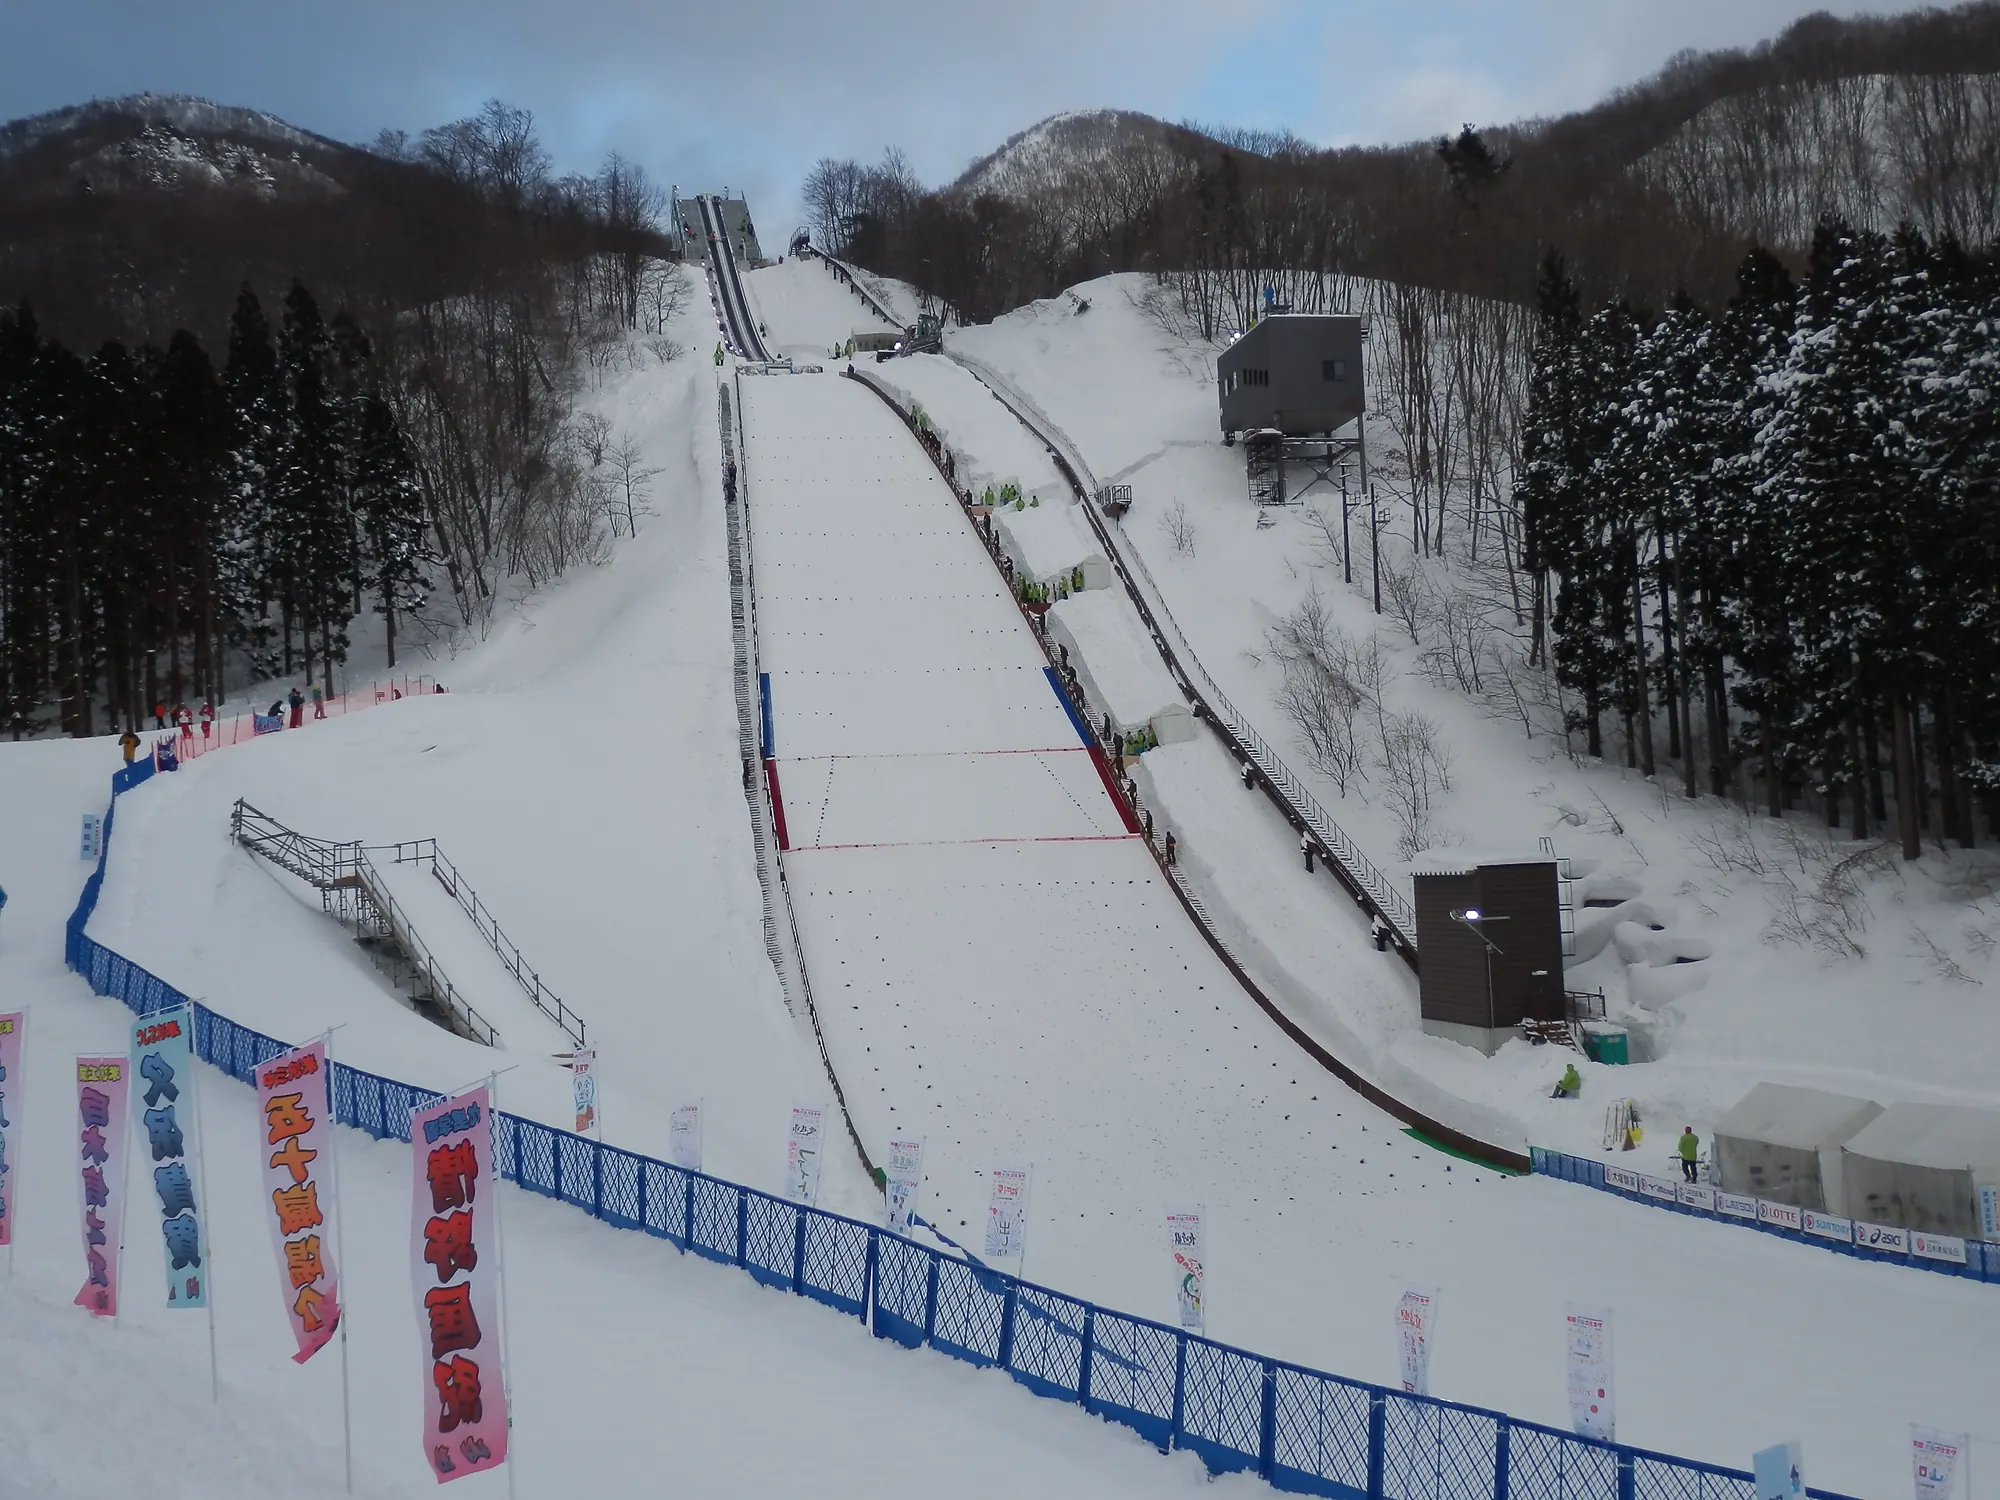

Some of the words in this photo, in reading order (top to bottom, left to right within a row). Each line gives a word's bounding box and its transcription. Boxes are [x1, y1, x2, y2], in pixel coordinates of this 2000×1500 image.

[1725, 1199, 1755, 1213] LAWSON
[1769, 1208, 1796, 1222] LOTTE
[1815, 1219, 1850, 1235] SUNTORY
